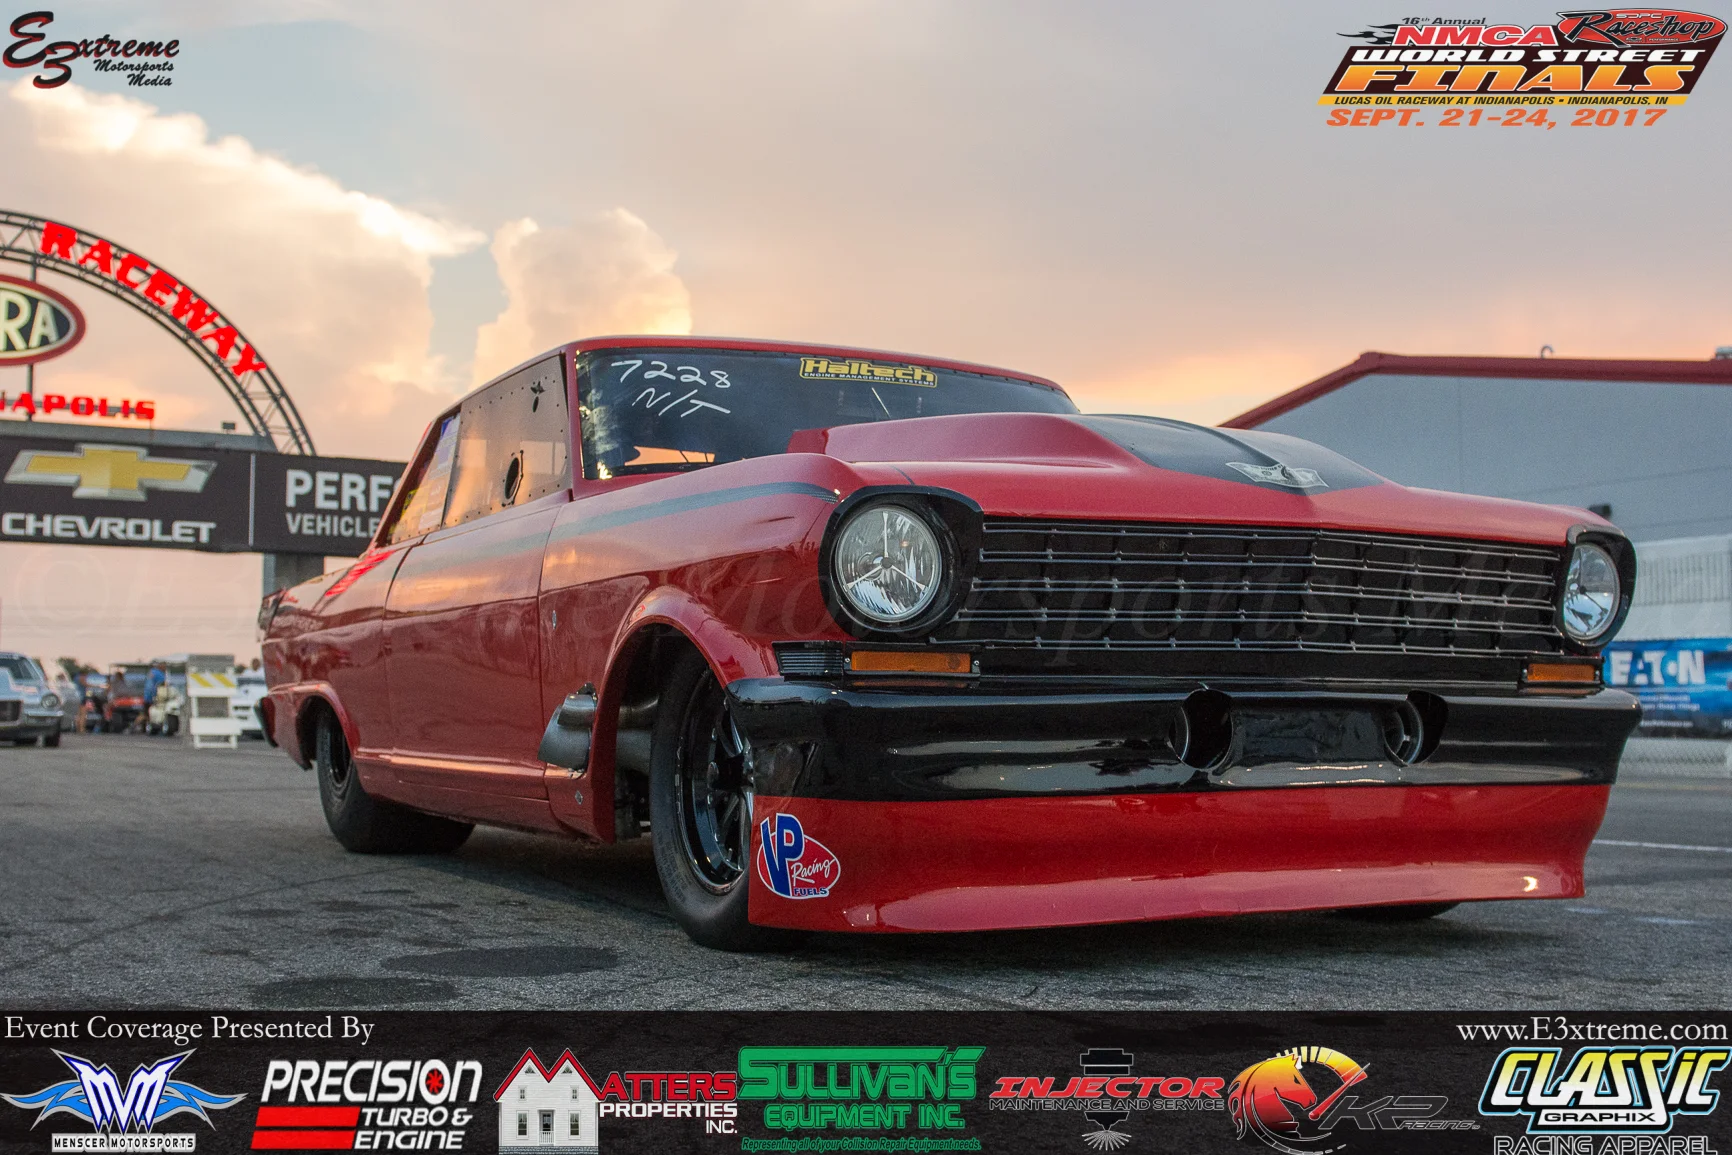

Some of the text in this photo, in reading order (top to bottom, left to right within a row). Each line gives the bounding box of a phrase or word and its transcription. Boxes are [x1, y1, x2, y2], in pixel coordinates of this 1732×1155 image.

[40, 221, 267, 376] RACEWAY
[611, 360, 731, 388] 7228
[804, 360, 934, 382] Haltech
[839, 374, 896, 382] MANAGEMENT
[0, 391, 155, 420] APOLIS
[286, 469, 400, 512] PERF
[2, 512, 217, 543] CHEVROLET
[760, 812, 804, 897] VP
[791, 858, 836, 886] Racing
[794, 888, 828, 896] FUELS
